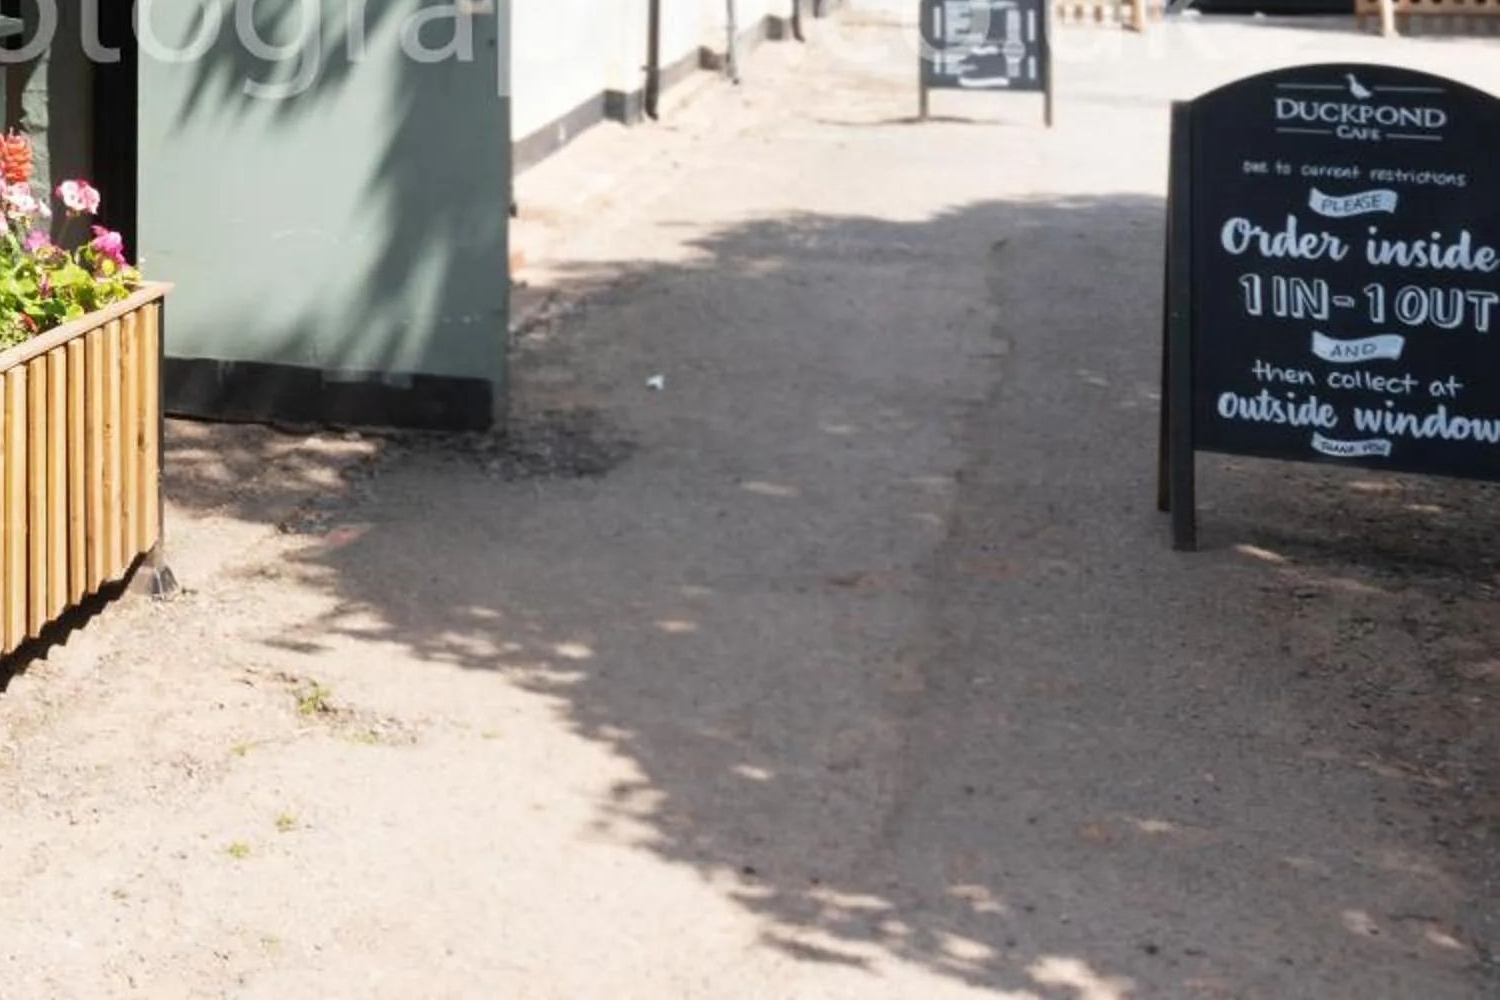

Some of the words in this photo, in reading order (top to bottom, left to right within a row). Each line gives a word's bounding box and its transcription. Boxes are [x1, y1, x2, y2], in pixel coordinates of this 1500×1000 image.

[1275, 98, 1447, 128] DUCKPOND
[1336, 125, 1381, 141] CAFE
[1276, 161, 1292, 175] to
[1301, 165, 1360, 180] current
[1370, 168, 1467, 187] restrictions
[1321, 194, 1382, 213] PLEASE
[1220, 214, 1348, 261] Order
[1366, 226, 1500, 272] inside
[1329, 343, 1378, 358] AND
[1252, 360, 1316, 385] then
[1327, 370, 1418, 394] collect
[1428, 375, 1463, 398] at
[1353, 400, 1500, 443] window
